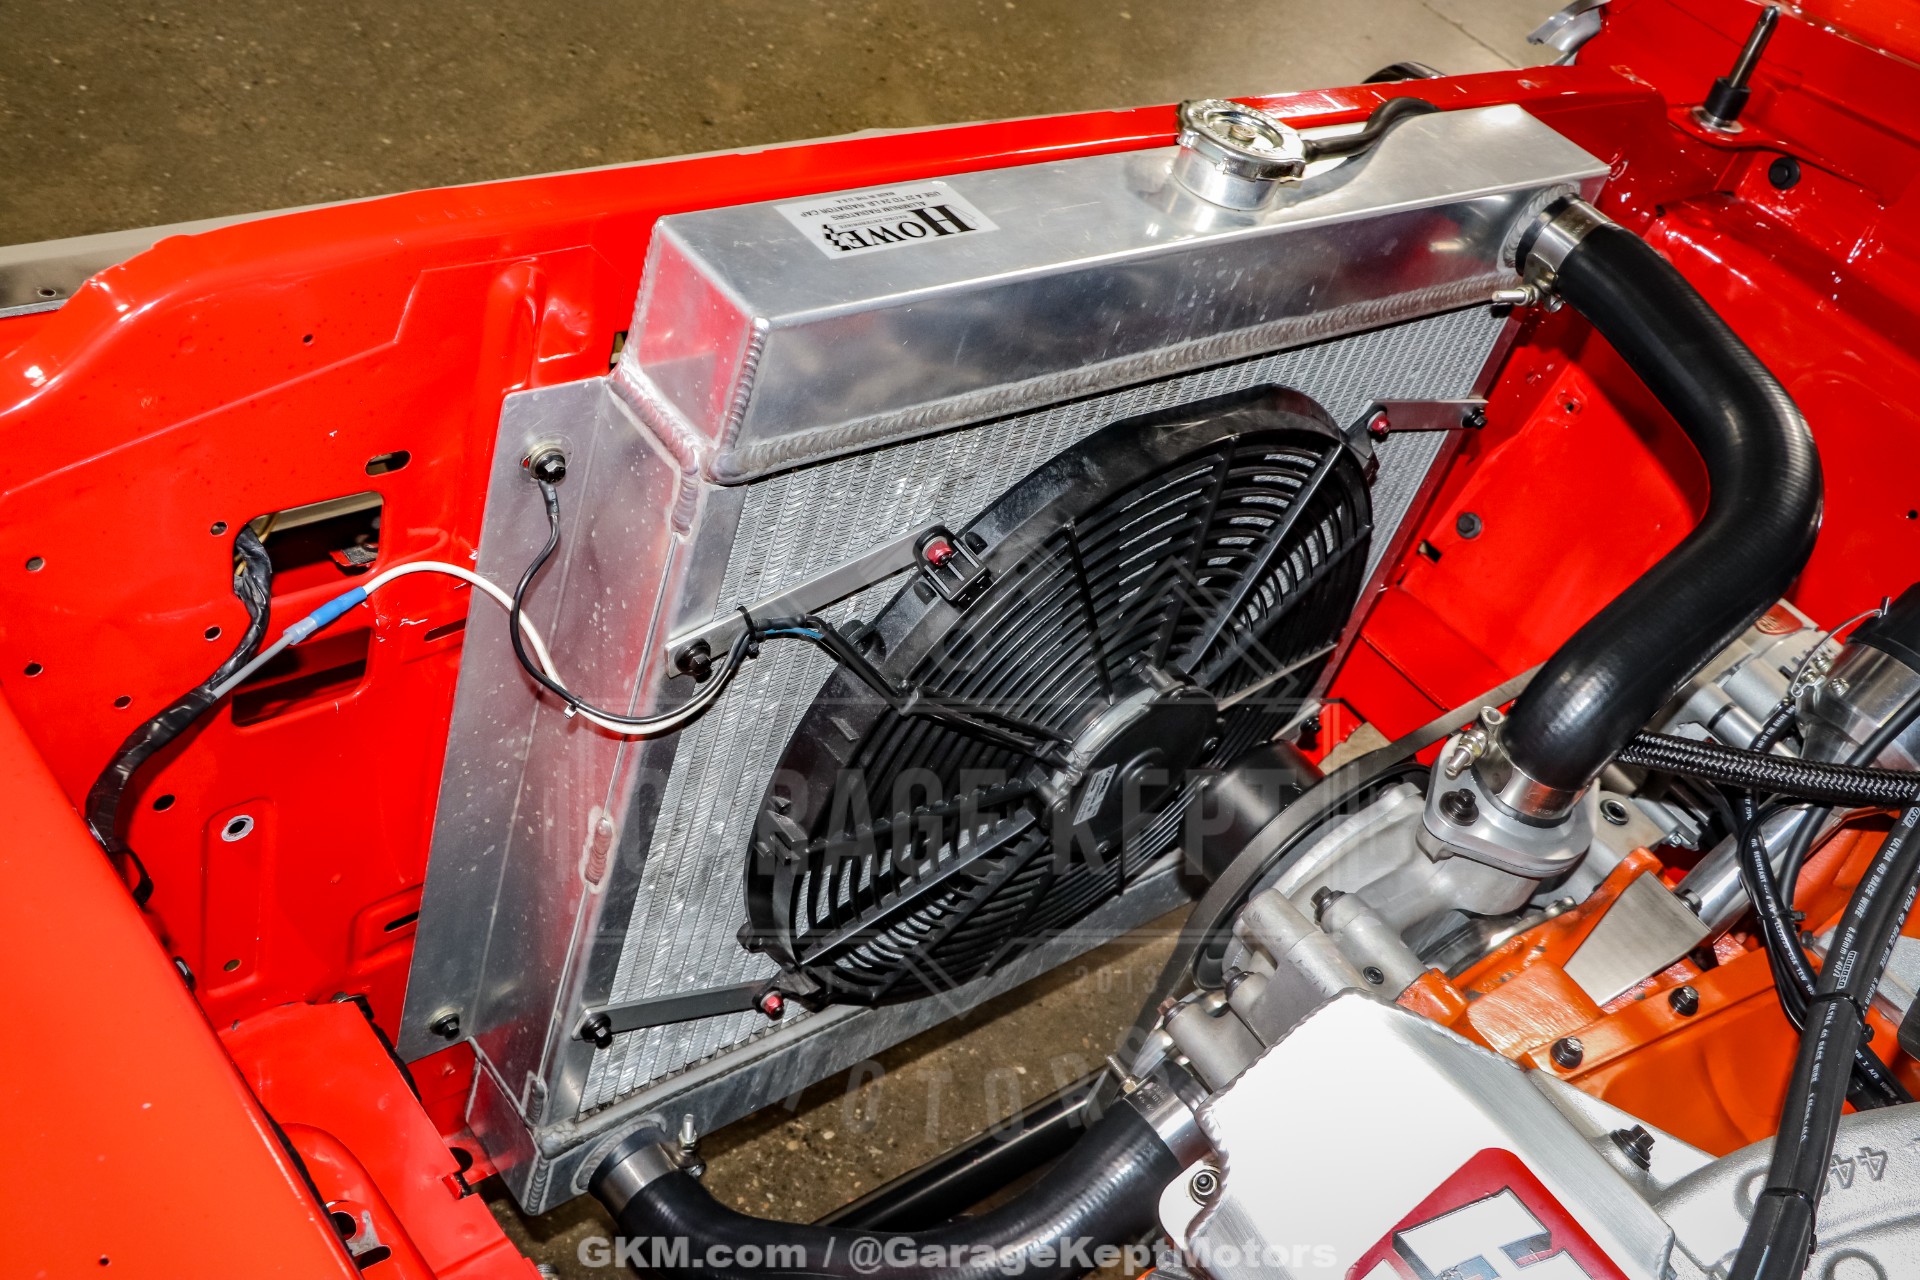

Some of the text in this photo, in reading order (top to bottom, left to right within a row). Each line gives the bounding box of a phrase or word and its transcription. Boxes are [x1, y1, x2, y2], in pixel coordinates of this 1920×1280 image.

[800, 209, 819, 218] CAP
[818, 203, 867, 214] RADIATOR
[830, 201, 926, 220] ALUMINUM RADIATORS
[836, 203, 978, 251] HOWE
[1882, 837, 1902, 863] ULTRA
[1753, 850, 1767, 884] RESISTANT
[1876, 863, 1888, 875] 40
[1864, 874, 1881, 897] RACE
[1854, 896, 1870, 919] WIRE
[1903, 885, 1917, 912] ULTRA
[1898, 912, 1906, 926] 40
[1888, 924, 1900, 947] RACE
[1879, 947, 1891, 968] WIRE
[1796, 966, 1808, 982] TEW
[1823, 1002, 1839, 1026] ULTRA
